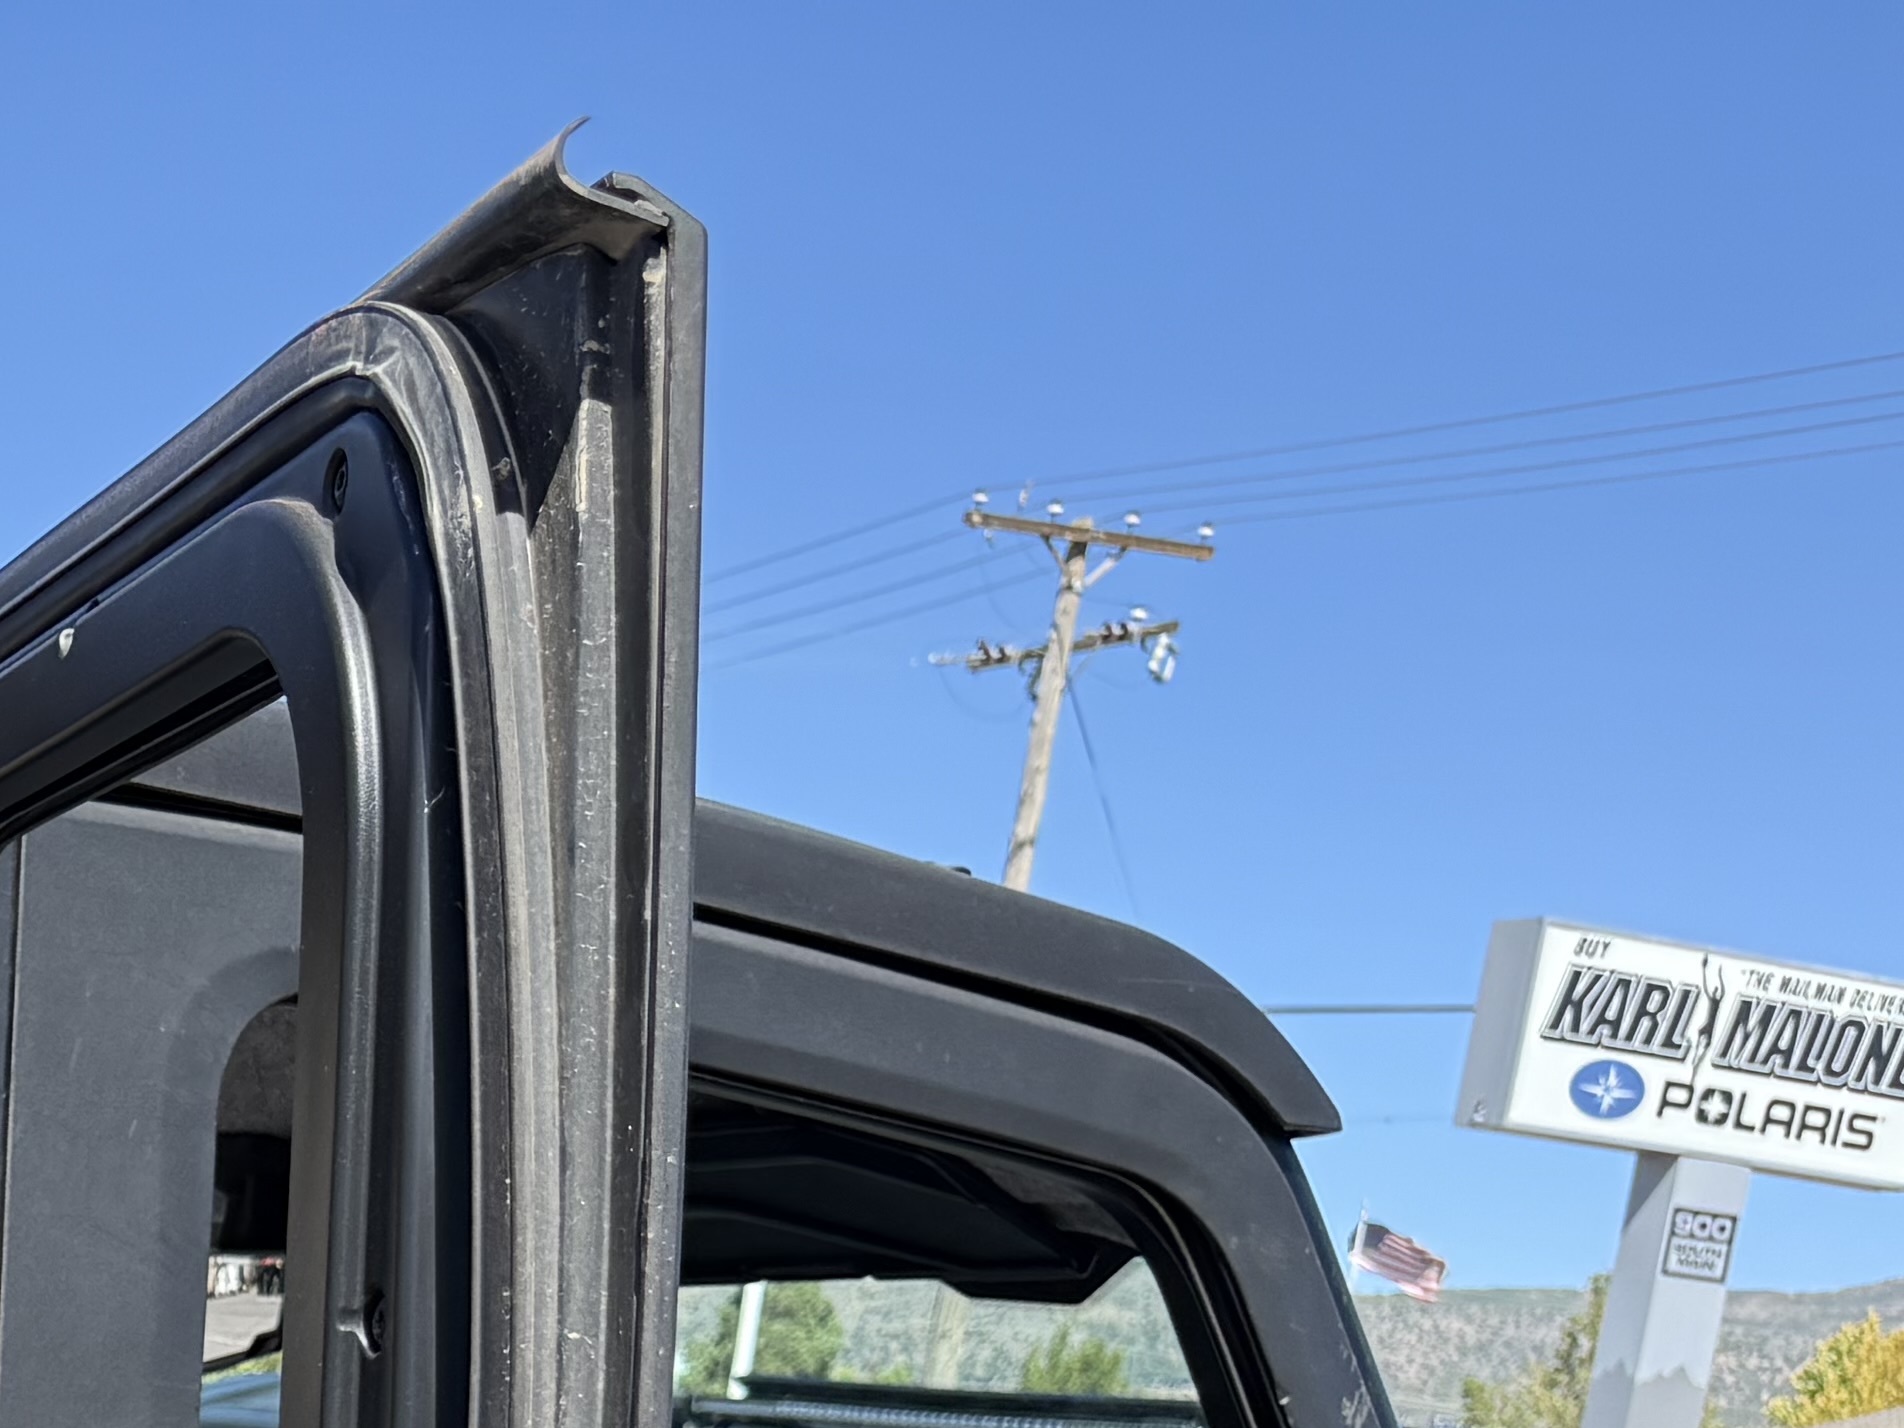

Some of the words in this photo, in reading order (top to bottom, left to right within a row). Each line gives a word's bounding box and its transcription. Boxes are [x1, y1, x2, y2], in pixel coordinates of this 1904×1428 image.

[1574, 937, 1611, 958] BUY
[1540, 962, 1700, 1063] KARL
[1657, 1080, 1879, 1151] POLARIS
